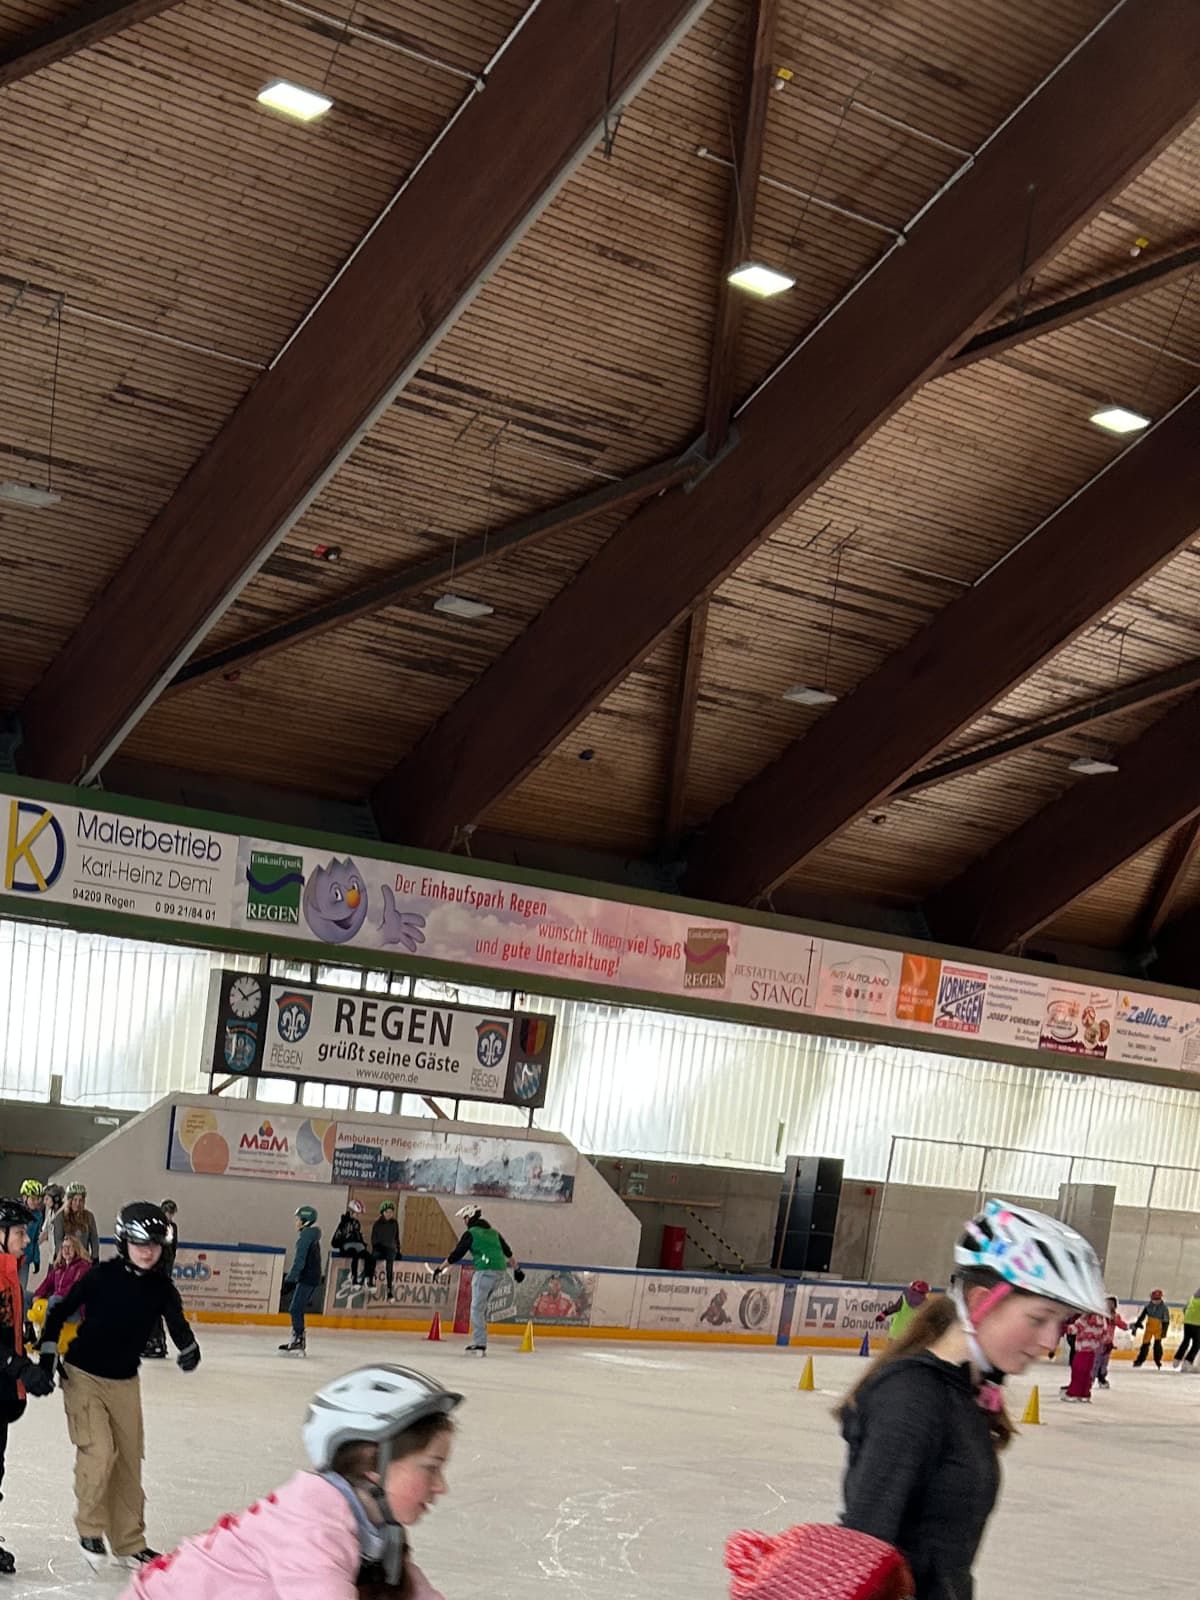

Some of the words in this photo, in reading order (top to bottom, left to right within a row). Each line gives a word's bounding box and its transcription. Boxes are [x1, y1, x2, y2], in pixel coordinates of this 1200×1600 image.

[76, 811, 223, 862] Malerbetrieb
[81, 855, 163, 888] Karl-Heinz
[72, 887, 102, 903] 94209
[104, 893, 136, 909] Regen
[177, 905, 203, 920] 21/84
[205, 908, 217, 921] 01
[395, 873, 416, 894] Der
[421, 878, 505, 911] Einkaufspark
[510, 892, 548, 917] Regen
[248, 903, 299, 922] REGEN
[538, 922, 588, 945] wünscht
[592, 928, 623, 950] Ihnen
[626, 935, 649, 955] viel
[654, 937, 682, 961] Spaß
[476, 937, 498, 955] und
[501, 942, 532, 962] gute
[536, 944, 621, 977] Unterhaltung!
[684, 973, 725, 988] REGEN
[734, 963, 806, 985] BESTATTUNGEN
[847, 971, 890, 987] AUTOLAND
[955, 992, 986, 1025] REGEN
[1126, 1005, 1173, 1029] Zellner
[334, 997, 454, 1047] REGEN
[270, 1048, 303, 1066] REGEN
[318, 1040, 364, 1062] grüßt
[368, 1046, 411, 1067] seine
[414, 1051, 460, 1073] Gäste
[355, 1067, 419, 1085] www.regen.de
[471, 1071, 500, 1090] REGEN
[239, 1133, 290, 1153] MaM
[338, 1132, 390, 1148] Ambulanter
